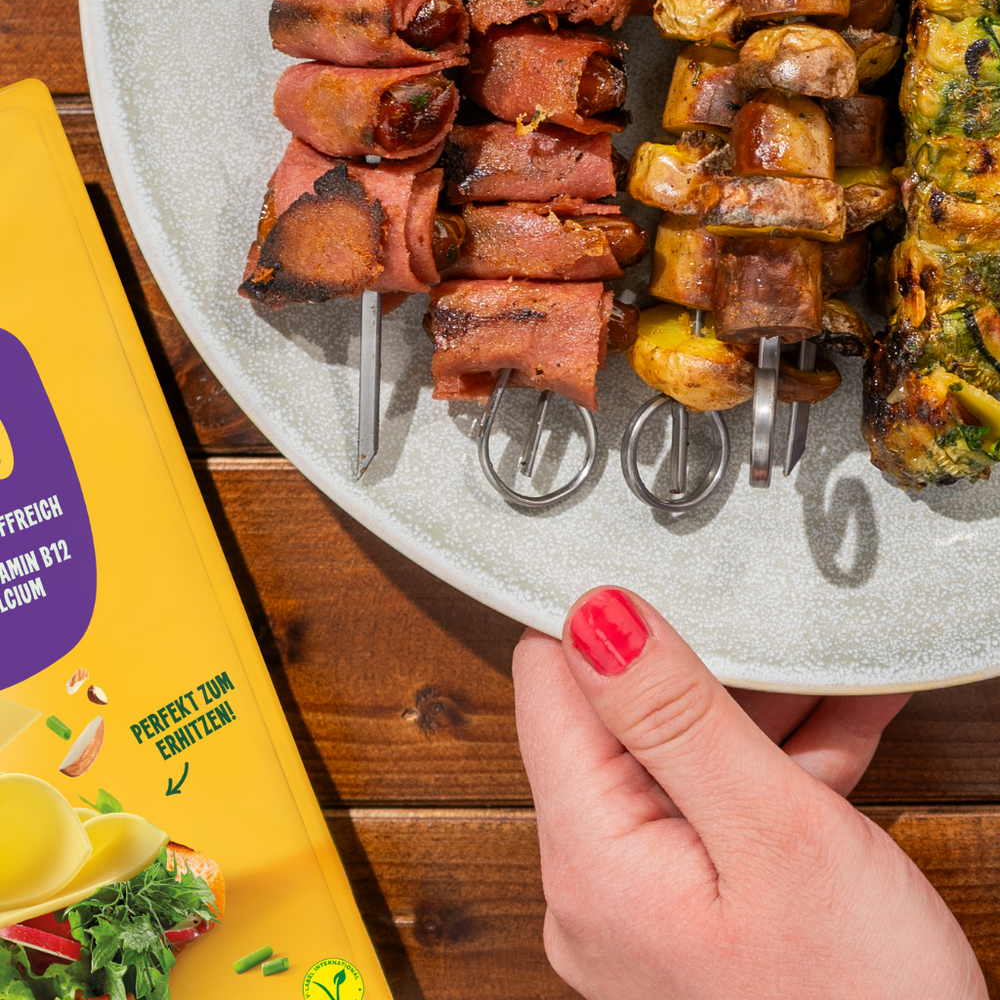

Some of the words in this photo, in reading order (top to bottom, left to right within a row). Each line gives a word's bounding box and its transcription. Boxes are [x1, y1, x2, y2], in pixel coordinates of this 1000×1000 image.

[39, 539, 72, 568] B12
[129, 690, 199, 745] PERFEKT
[196, 671, 235, 705] ZUM
[155, 700, 237, 761] ERHITZEN!
[313, 960, 359, 981] INTERNATIONAL
